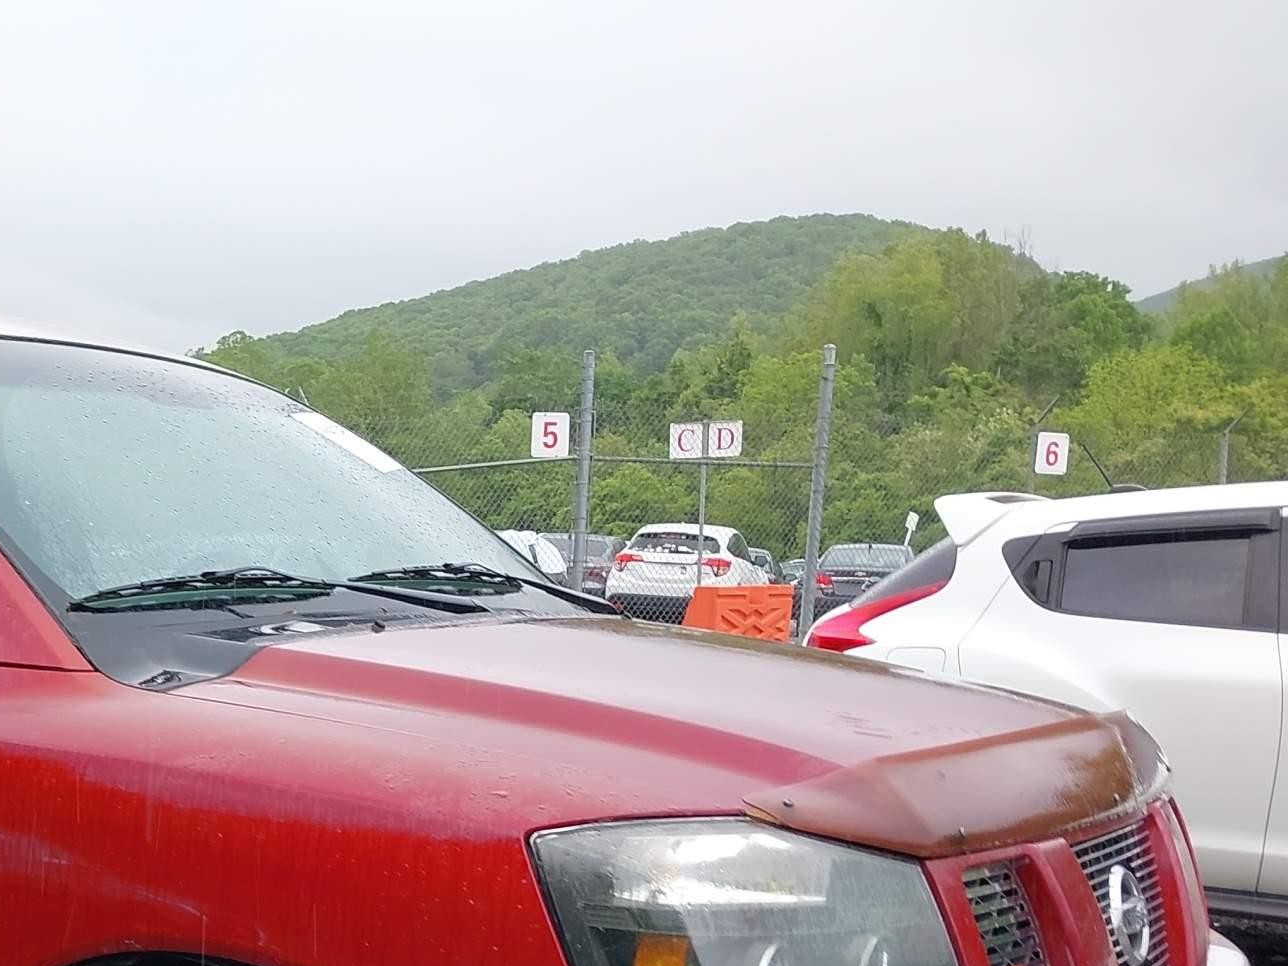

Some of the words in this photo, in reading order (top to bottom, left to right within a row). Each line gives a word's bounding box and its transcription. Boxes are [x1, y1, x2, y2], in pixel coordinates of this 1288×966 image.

[543, 422, 558, 448] 5
[677, 428, 694, 452] C
[717, 427, 735, 450] D
[1046, 441, 1060, 466] 6
